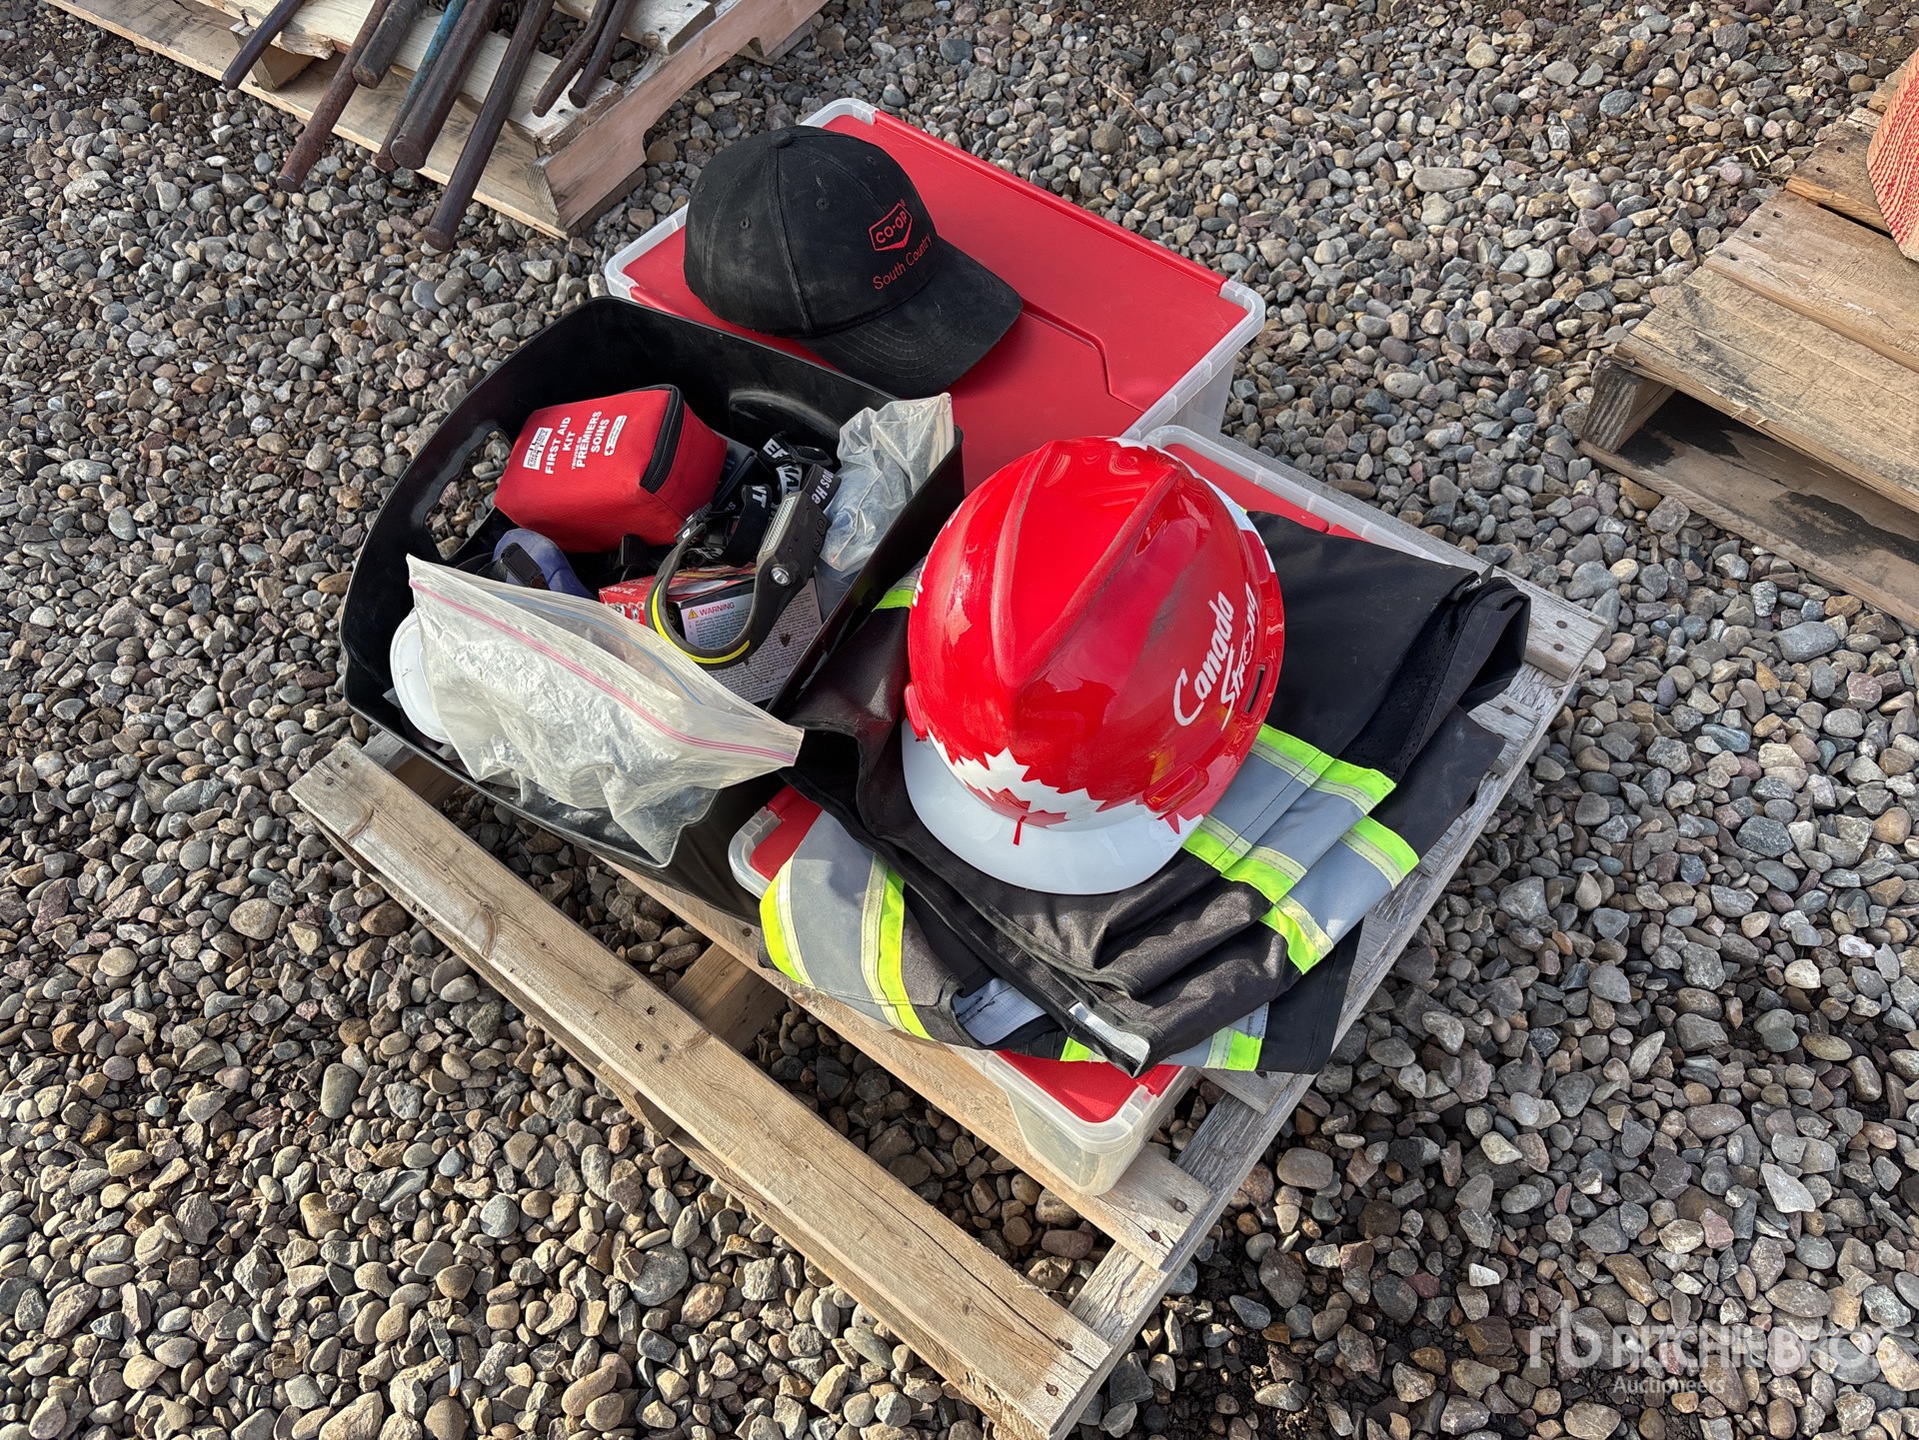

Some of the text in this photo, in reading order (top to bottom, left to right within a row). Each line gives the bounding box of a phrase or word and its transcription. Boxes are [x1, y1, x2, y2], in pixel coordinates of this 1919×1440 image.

[875, 210, 908, 244] CO-OP
[873, 234, 931, 290] South Country
[545, 417, 571, 474] FIRST AID
[562, 431, 576, 451] KIT
[576, 411, 602, 468] PREMIERS
[591, 419, 610, 453] SOINS
[699, 601, 736, 616] WARNING
[1173, 591, 1235, 726] Canada
